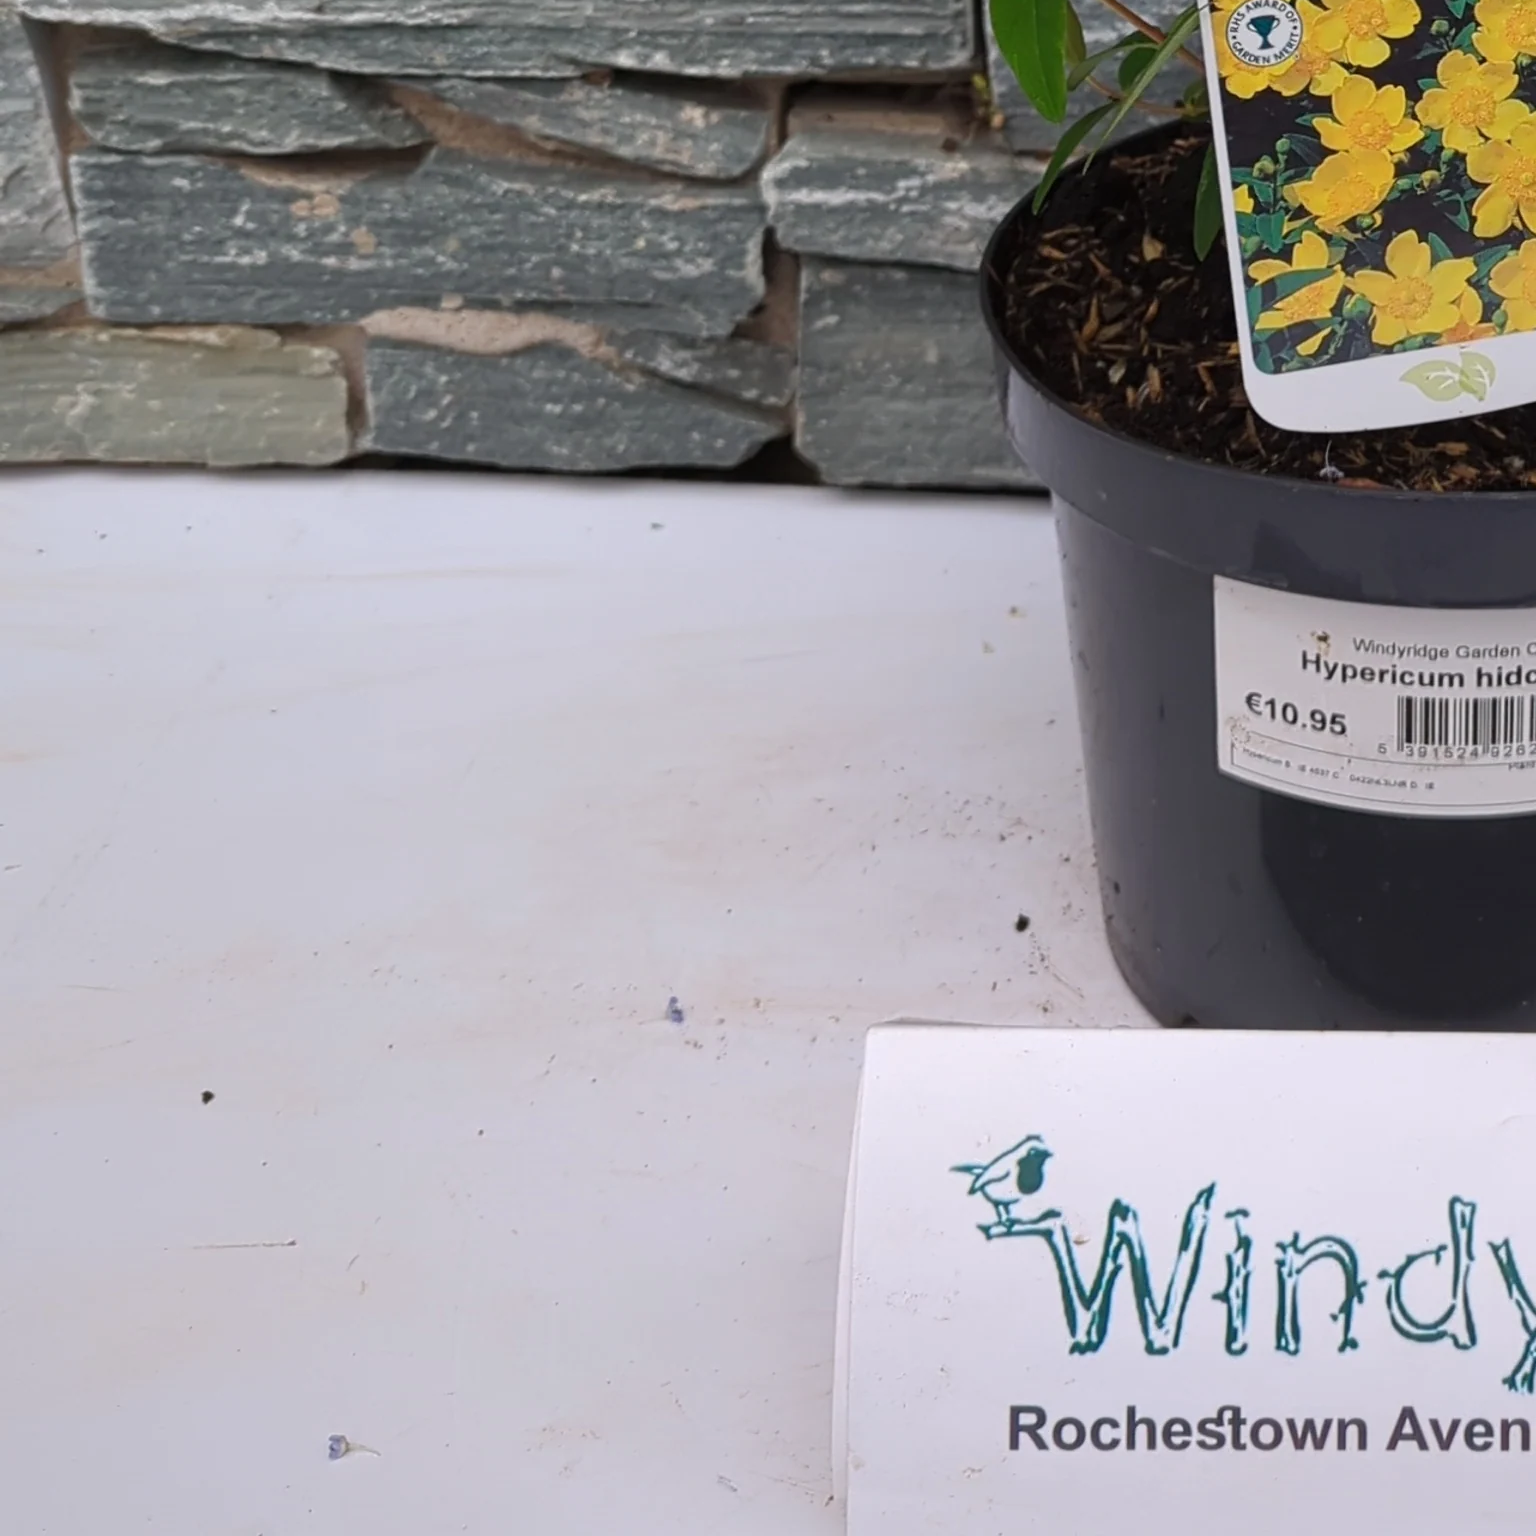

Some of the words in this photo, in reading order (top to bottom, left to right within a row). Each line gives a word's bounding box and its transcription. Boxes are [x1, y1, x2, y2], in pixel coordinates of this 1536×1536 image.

[1229, 11, 1246, 33] RHS
[1244, 0, 1287, 13] AWARD
[1285, 10, 1299, 24] OF
[1231, 41, 1271, 64] GARDEN
[1273, 32, 1299, 61] MERIT
[1352, 636, 1450, 661] Windyridge
[1455, 643, 1521, 659] Garden
[1301, 649, 1465, 688] Hypericum
[1244, 691, 1348, 736] €10.95
[1008, 1405, 1368, 1453] Rochestown
